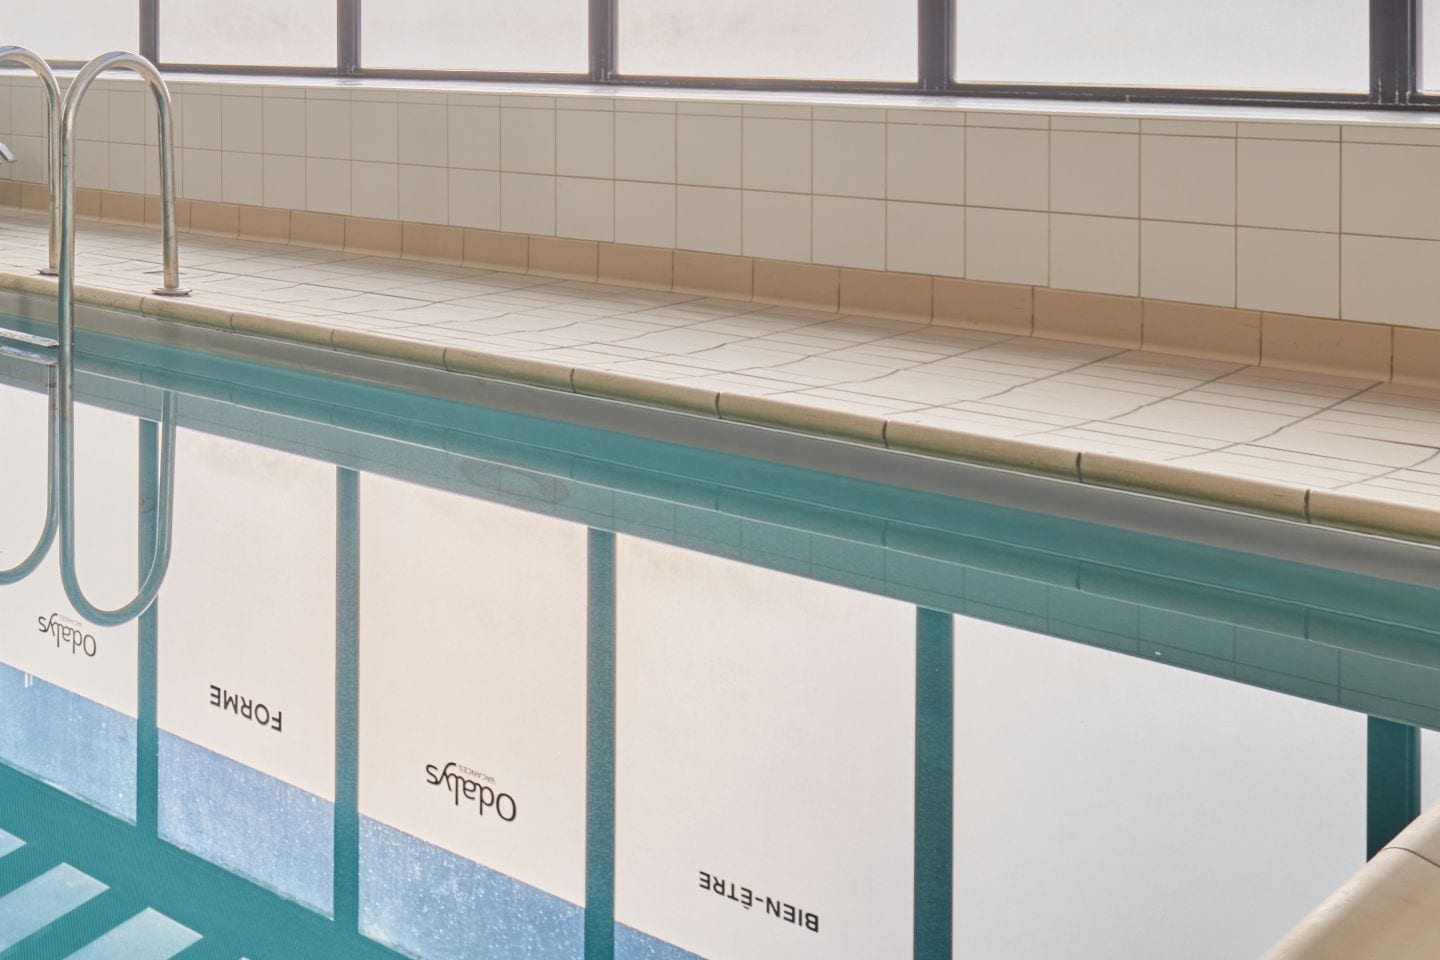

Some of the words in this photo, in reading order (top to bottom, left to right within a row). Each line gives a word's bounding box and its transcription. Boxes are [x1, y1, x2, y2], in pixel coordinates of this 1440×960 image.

[37, 612, 97, 658] Odalys
[209, 683, 283, 734] FORME
[425, 761, 518, 823] Odalys
[698, 870, 820, 934] BIEN-ÊTRE
